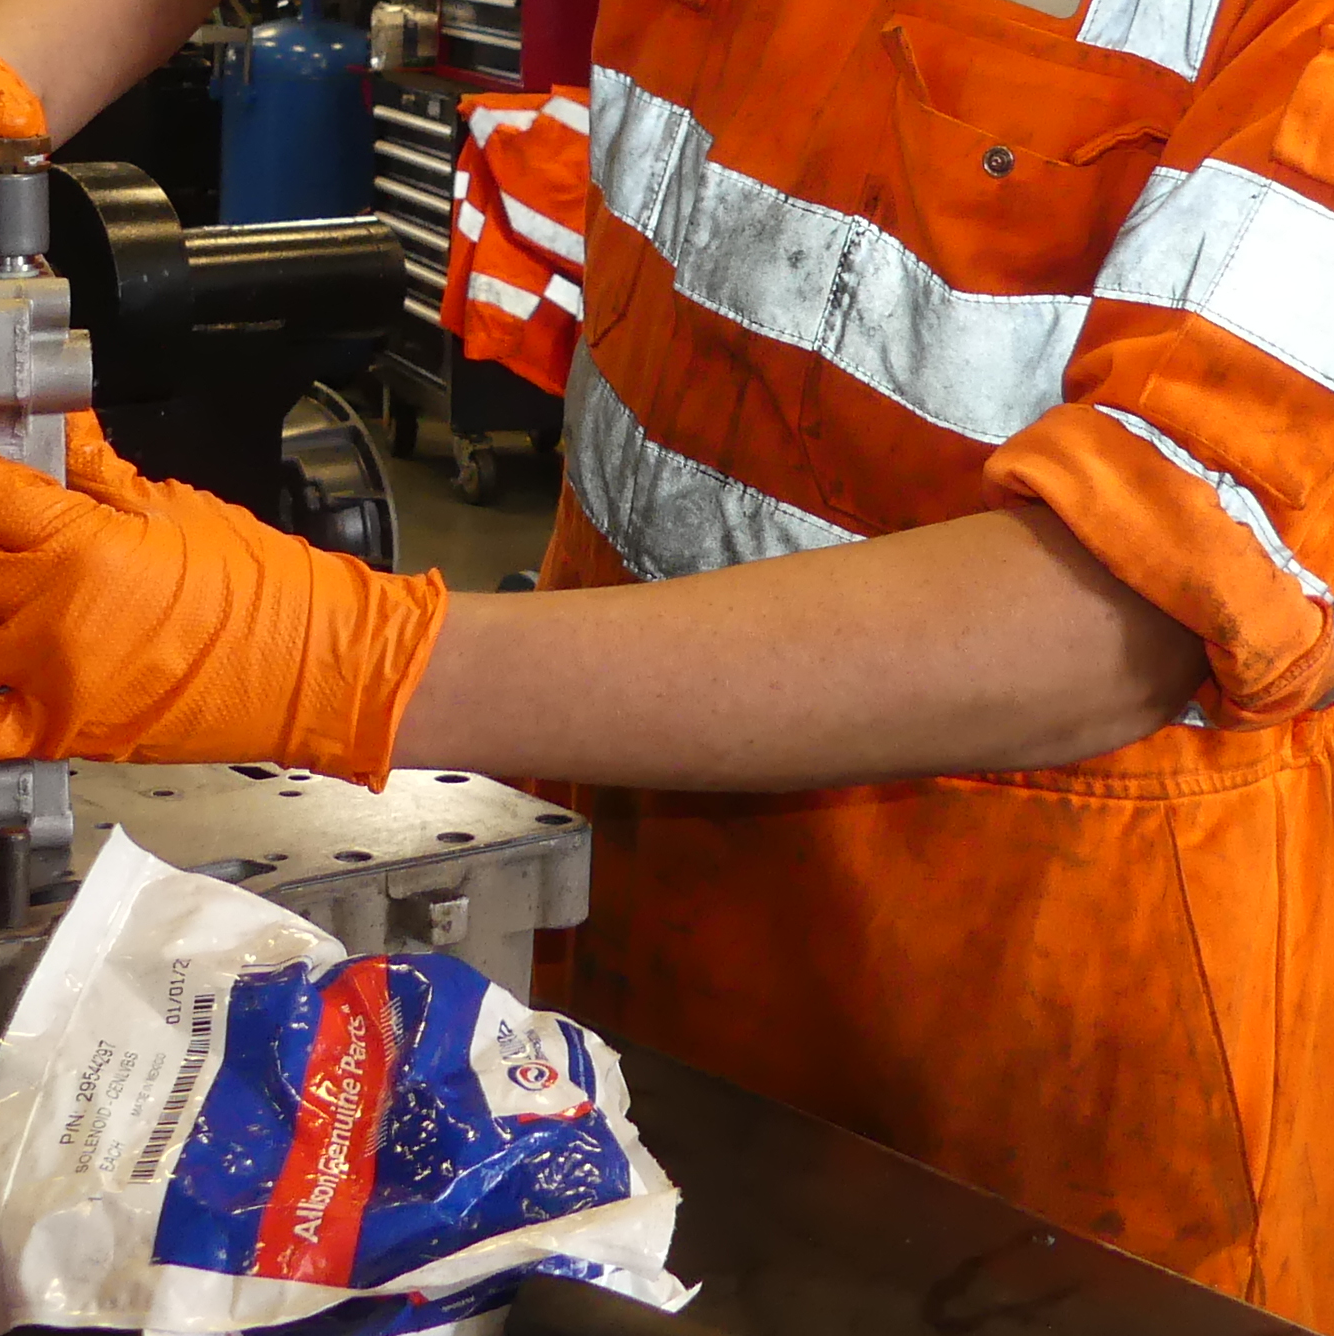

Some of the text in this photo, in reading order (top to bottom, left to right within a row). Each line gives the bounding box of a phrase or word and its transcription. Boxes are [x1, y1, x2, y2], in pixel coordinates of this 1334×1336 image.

[60, 1040, 116, 1144] P/N: 29544297
[293, 1014, 367, 1244] Allison Genuine Parts
[75, 1107, 111, 1174] SOLENOID
[99, 1140, 126, 1172] EACH
